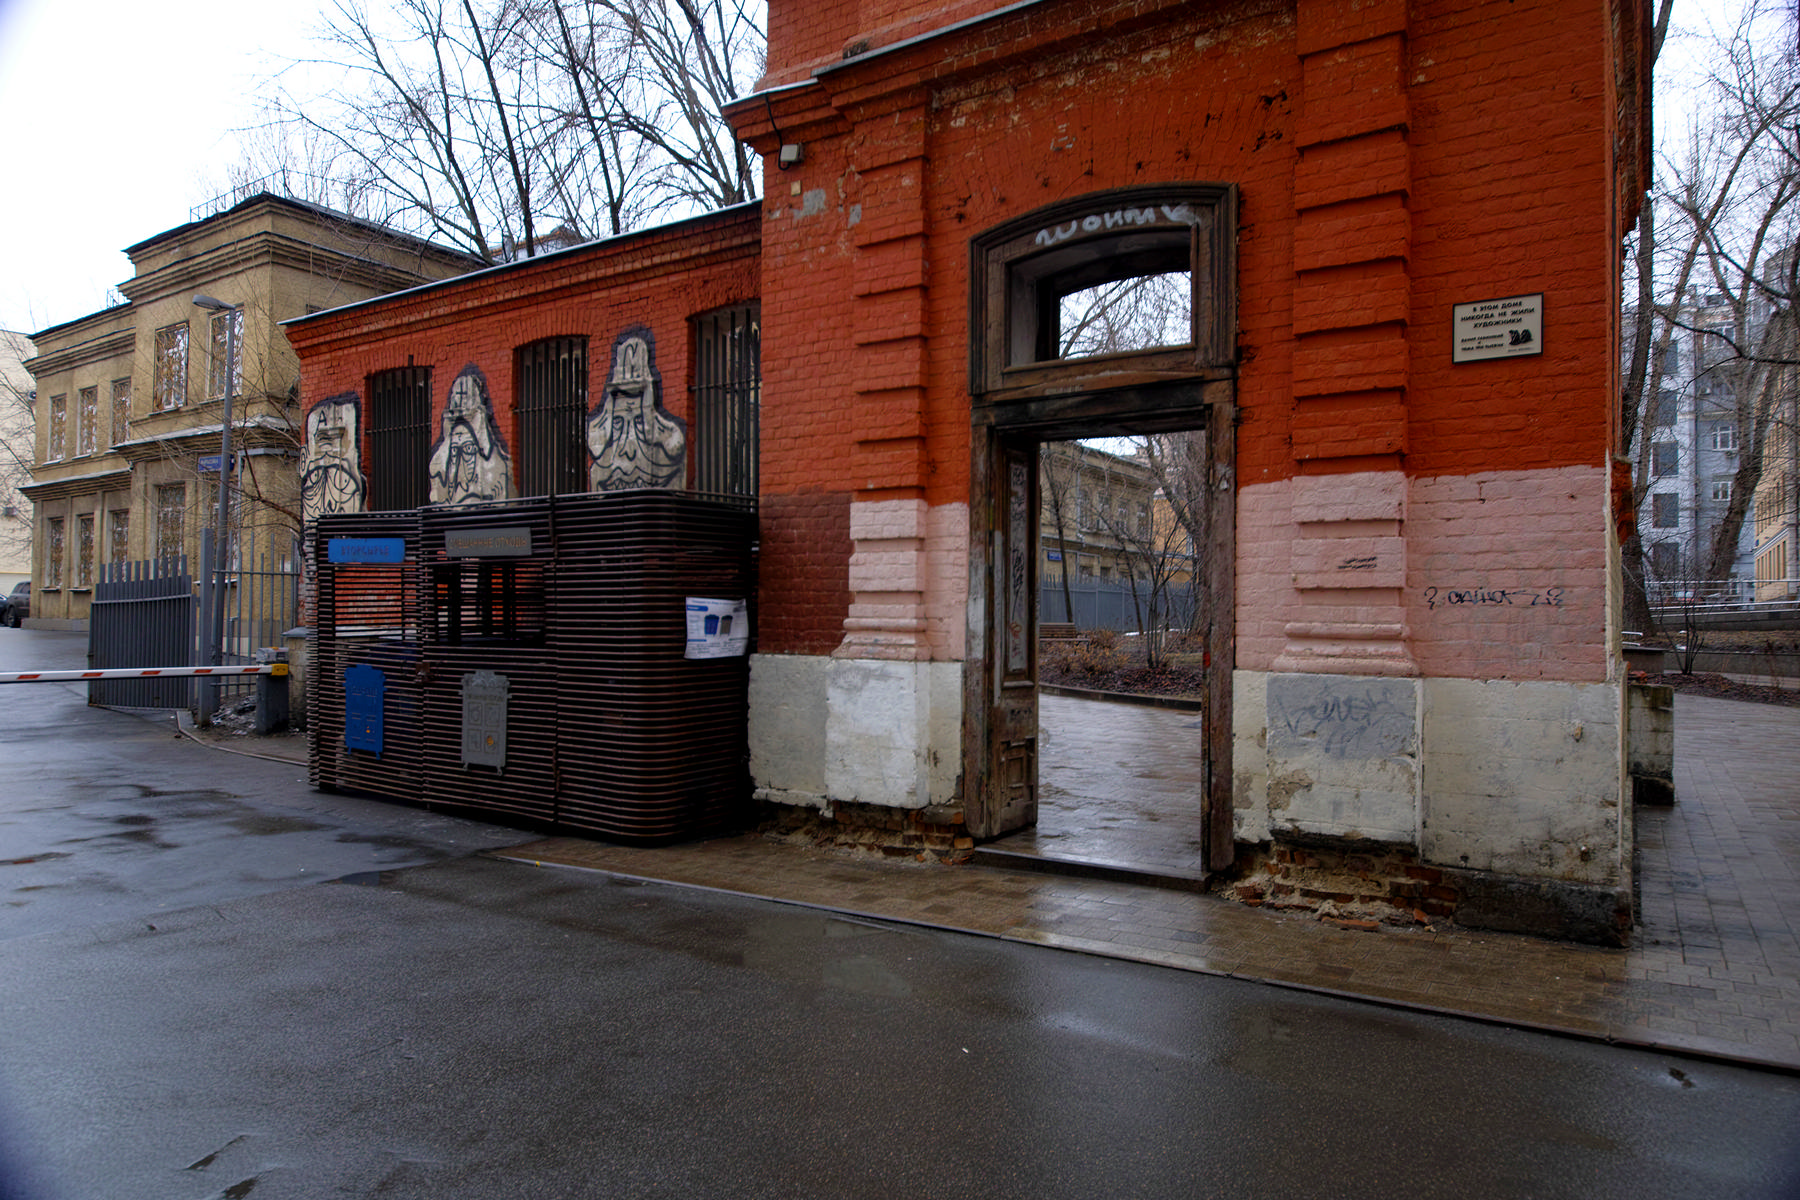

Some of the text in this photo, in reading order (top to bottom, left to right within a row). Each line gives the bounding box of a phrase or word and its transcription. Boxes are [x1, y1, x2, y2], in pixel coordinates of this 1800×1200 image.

[1480, 304, 1498, 312] ЭТОМ
[1501, 301, 1522, 309] ДОМЕ
[1461, 313, 1494, 322] НИКОГДА
[1511, 307, 1535, 316] ЖИЛИ
[1473, 317, 1522, 328] ХУДОЖНИКИ
